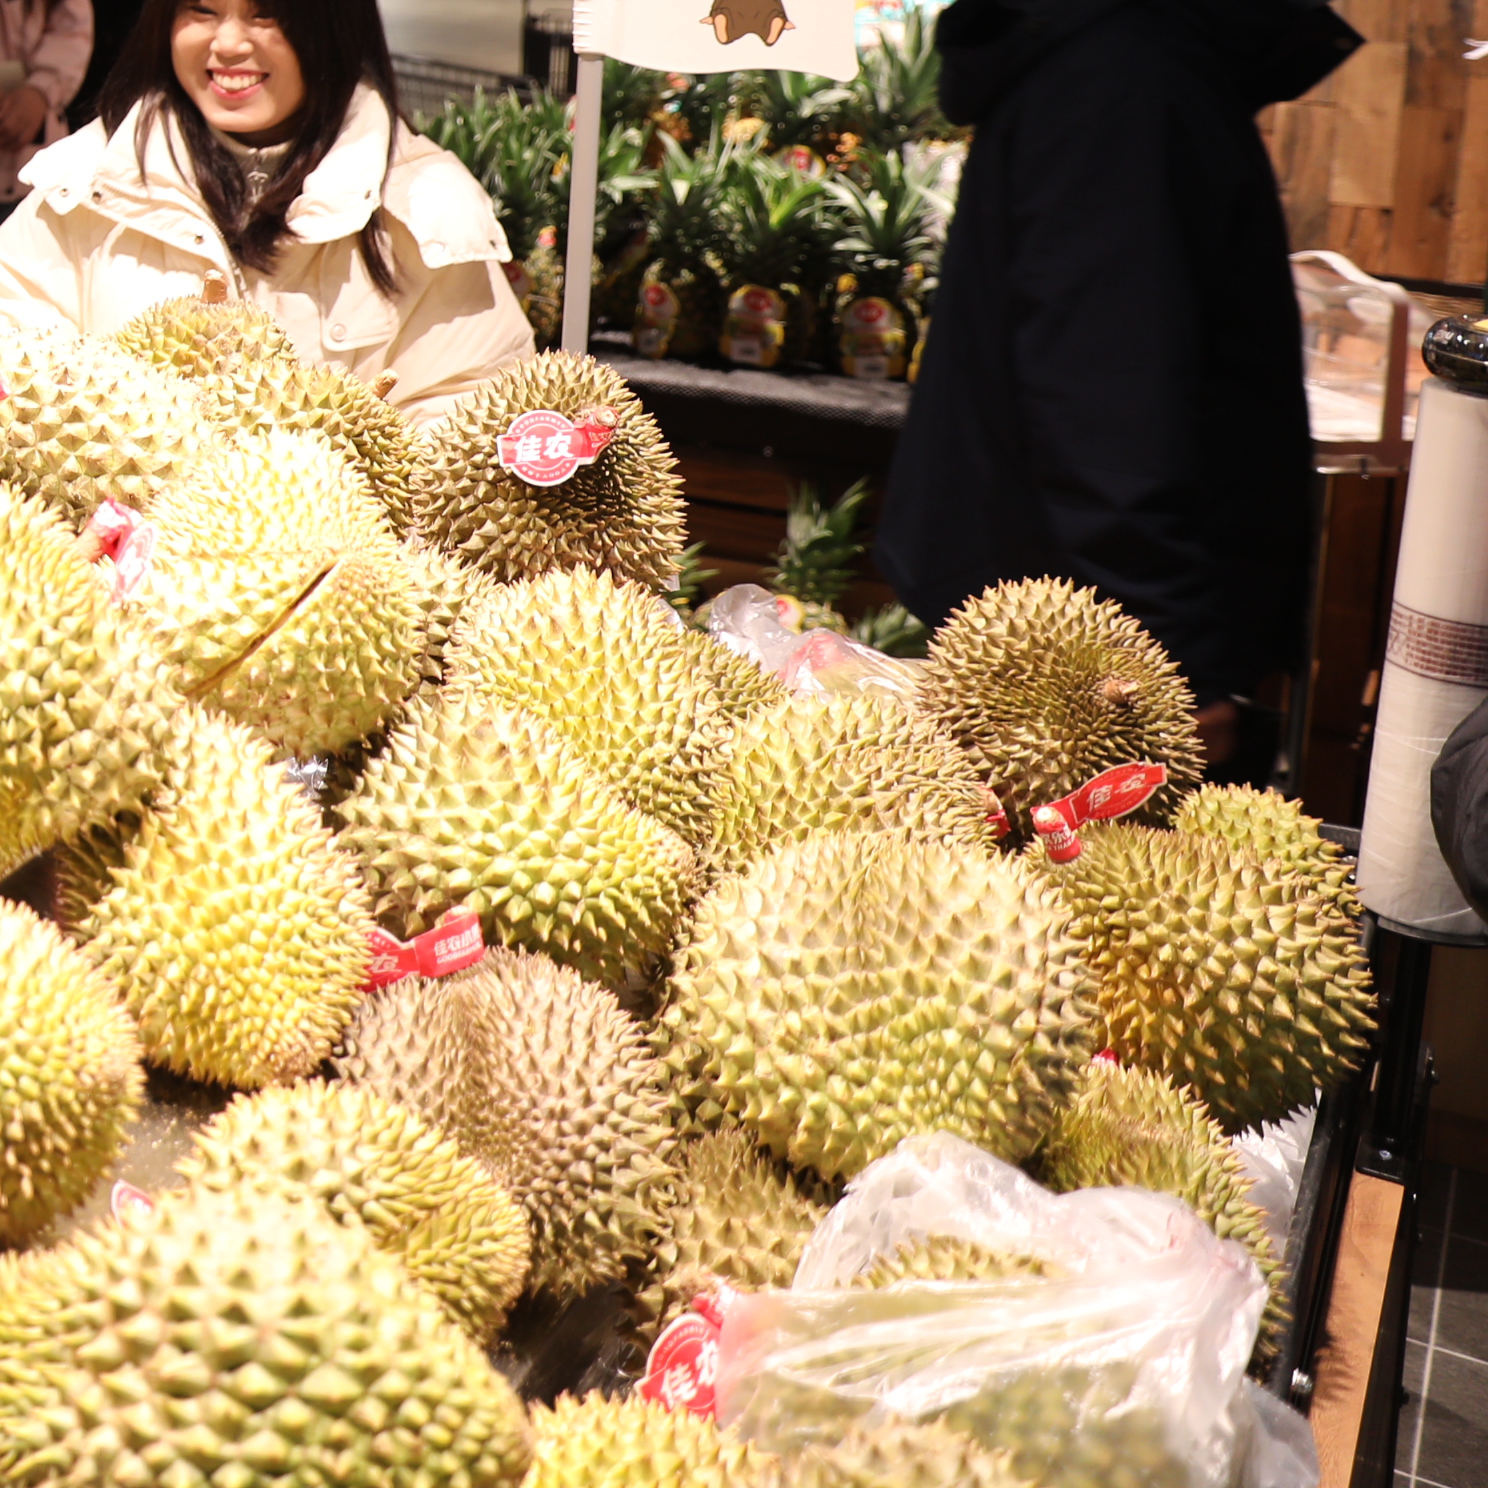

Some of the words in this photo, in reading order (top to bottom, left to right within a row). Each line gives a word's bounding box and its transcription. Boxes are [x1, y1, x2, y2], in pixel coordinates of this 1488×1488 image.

[513, 431, 575, 463] 佳农
[1086, 772, 1148, 813] 佳农
[660, 1339, 718, 1410] 佳农
